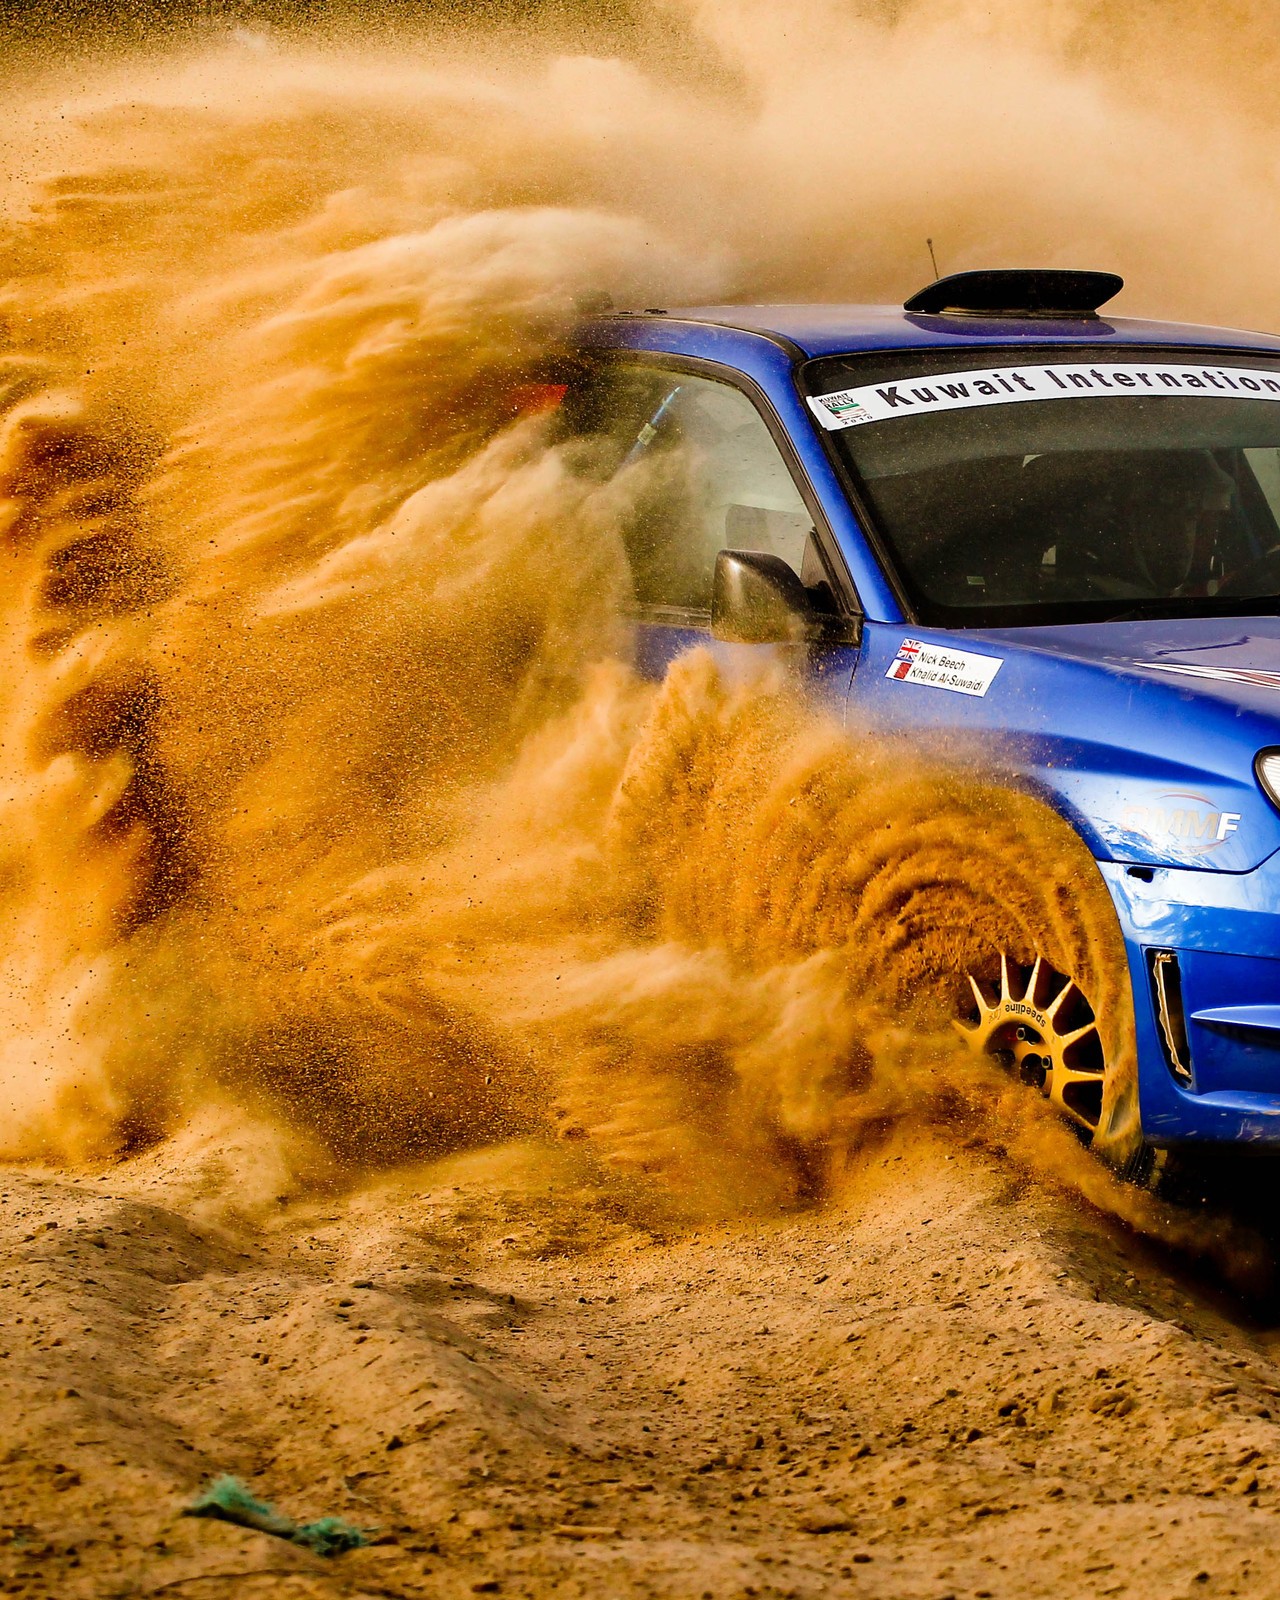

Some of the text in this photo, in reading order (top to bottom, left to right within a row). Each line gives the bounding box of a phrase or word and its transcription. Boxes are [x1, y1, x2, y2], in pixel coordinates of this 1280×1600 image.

[818, 393, 850, 404] KUWAIT
[875, 371, 1034, 408] Kuwait
[824, 398, 854, 409] RALLY
[918, 652, 966, 671] Nick Beech
[910, 666, 984, 691] Khalid Al-Suwaidi
[1005, 1003, 1047, 1028] speedline
